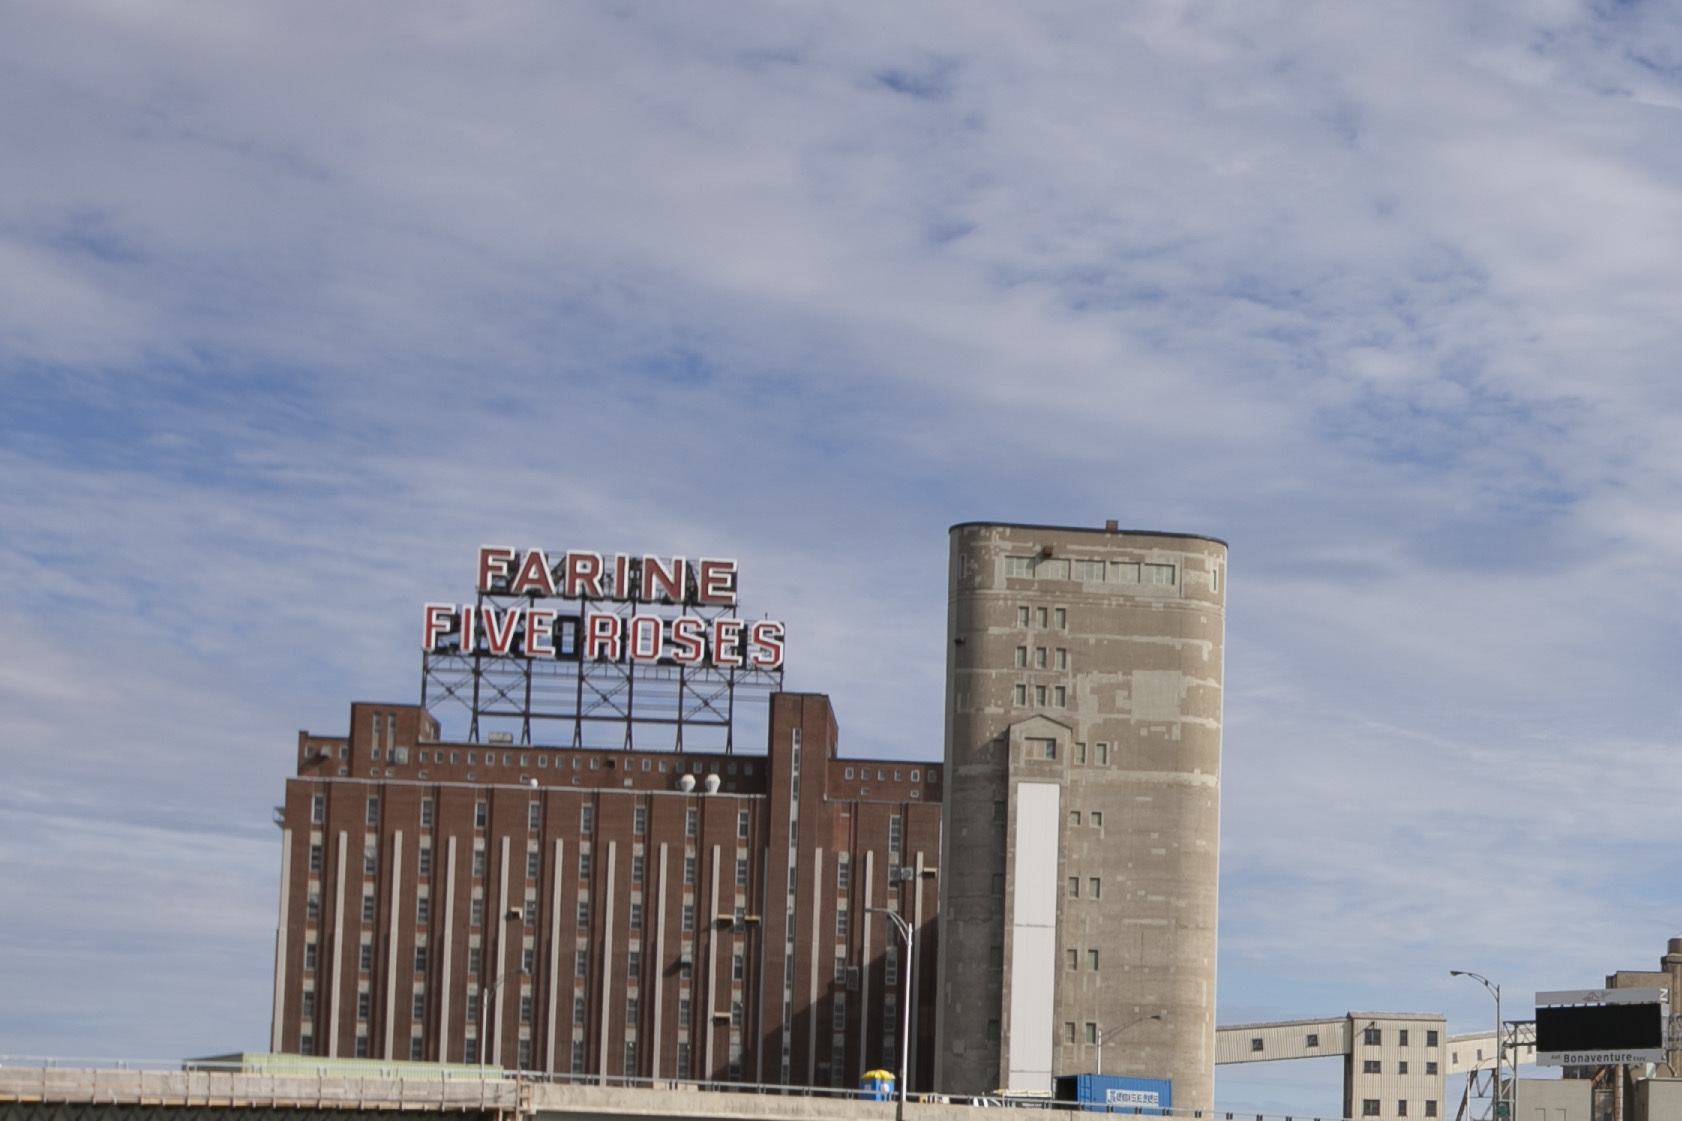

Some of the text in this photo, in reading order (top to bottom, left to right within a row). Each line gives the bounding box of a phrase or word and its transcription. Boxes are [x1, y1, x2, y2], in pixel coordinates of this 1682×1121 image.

[477, 545, 738, 605] FARINE
[423, 603, 785, 669] FIVE ROSES
[1563, 1052, 1632, 1063] Bonaventure
